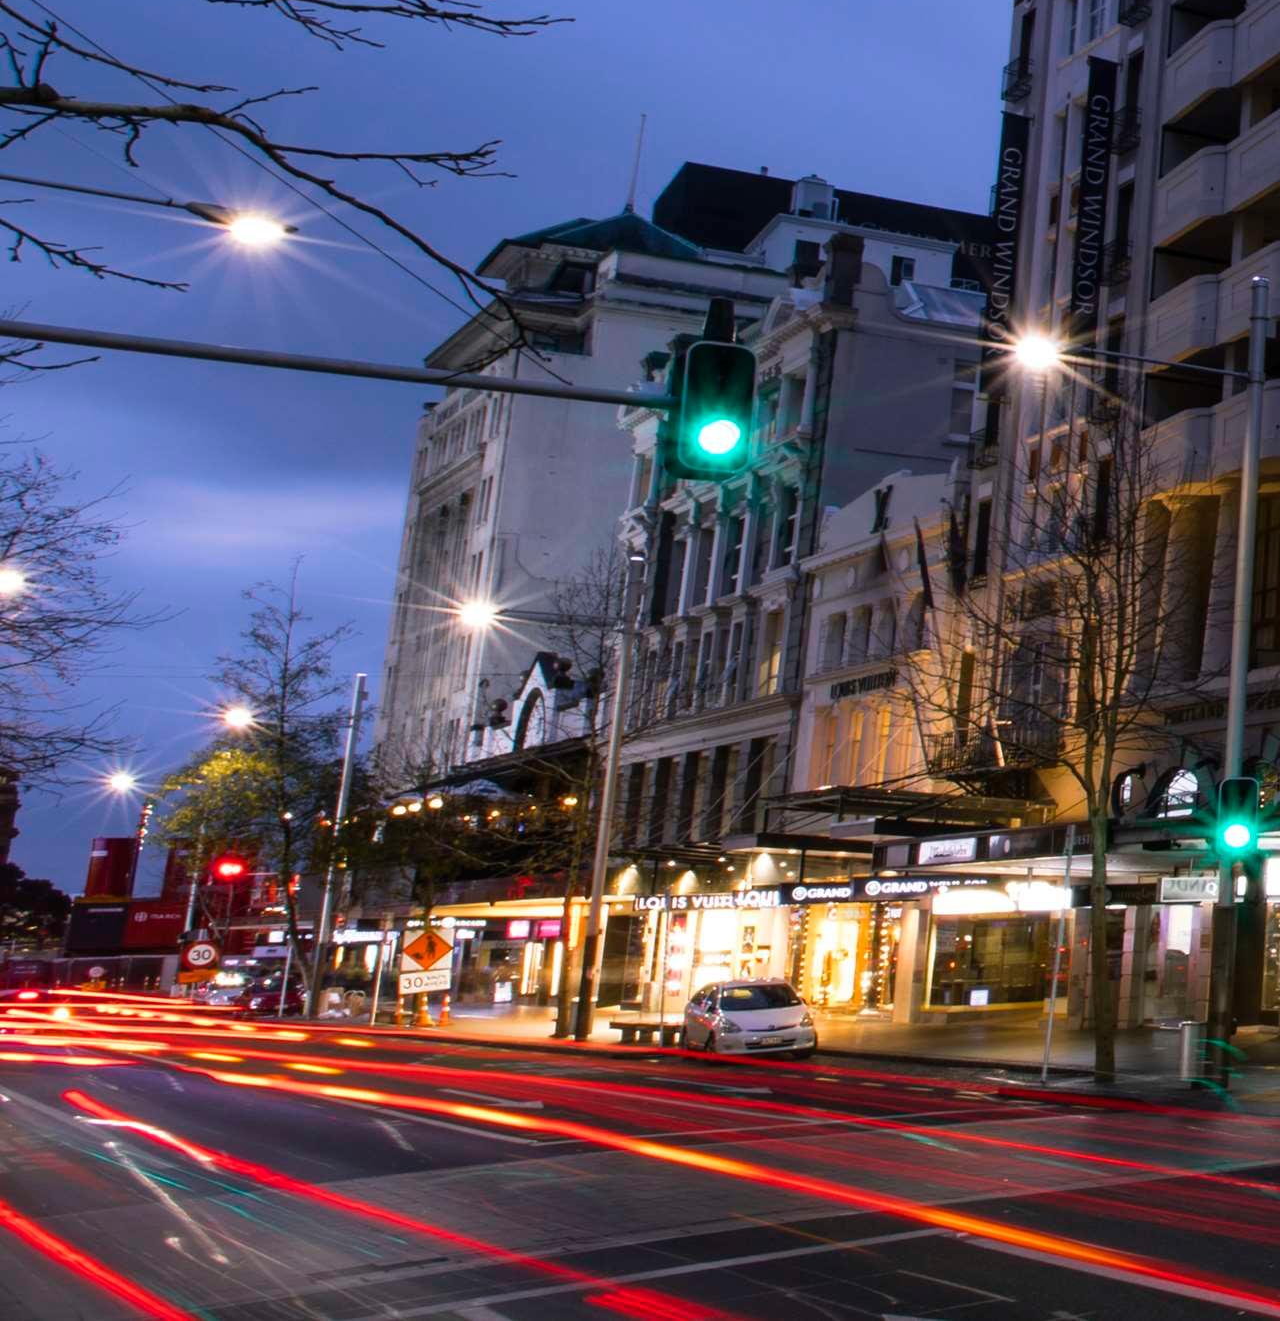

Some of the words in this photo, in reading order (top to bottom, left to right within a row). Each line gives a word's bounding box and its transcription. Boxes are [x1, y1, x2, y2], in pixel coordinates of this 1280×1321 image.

[1084, 94, 1110, 185] GRAND
[998, 147, 1023, 232] GRAND
[1075, 195, 1103, 316] WINDSOR
[987, 241, 1016, 356] WINDSOR
[807, 887, 852, 899] GRAND
[881, 881, 928, 895] GRAND
[191, 948, 212, 962] 30
[402, 977, 423, 990] 30
